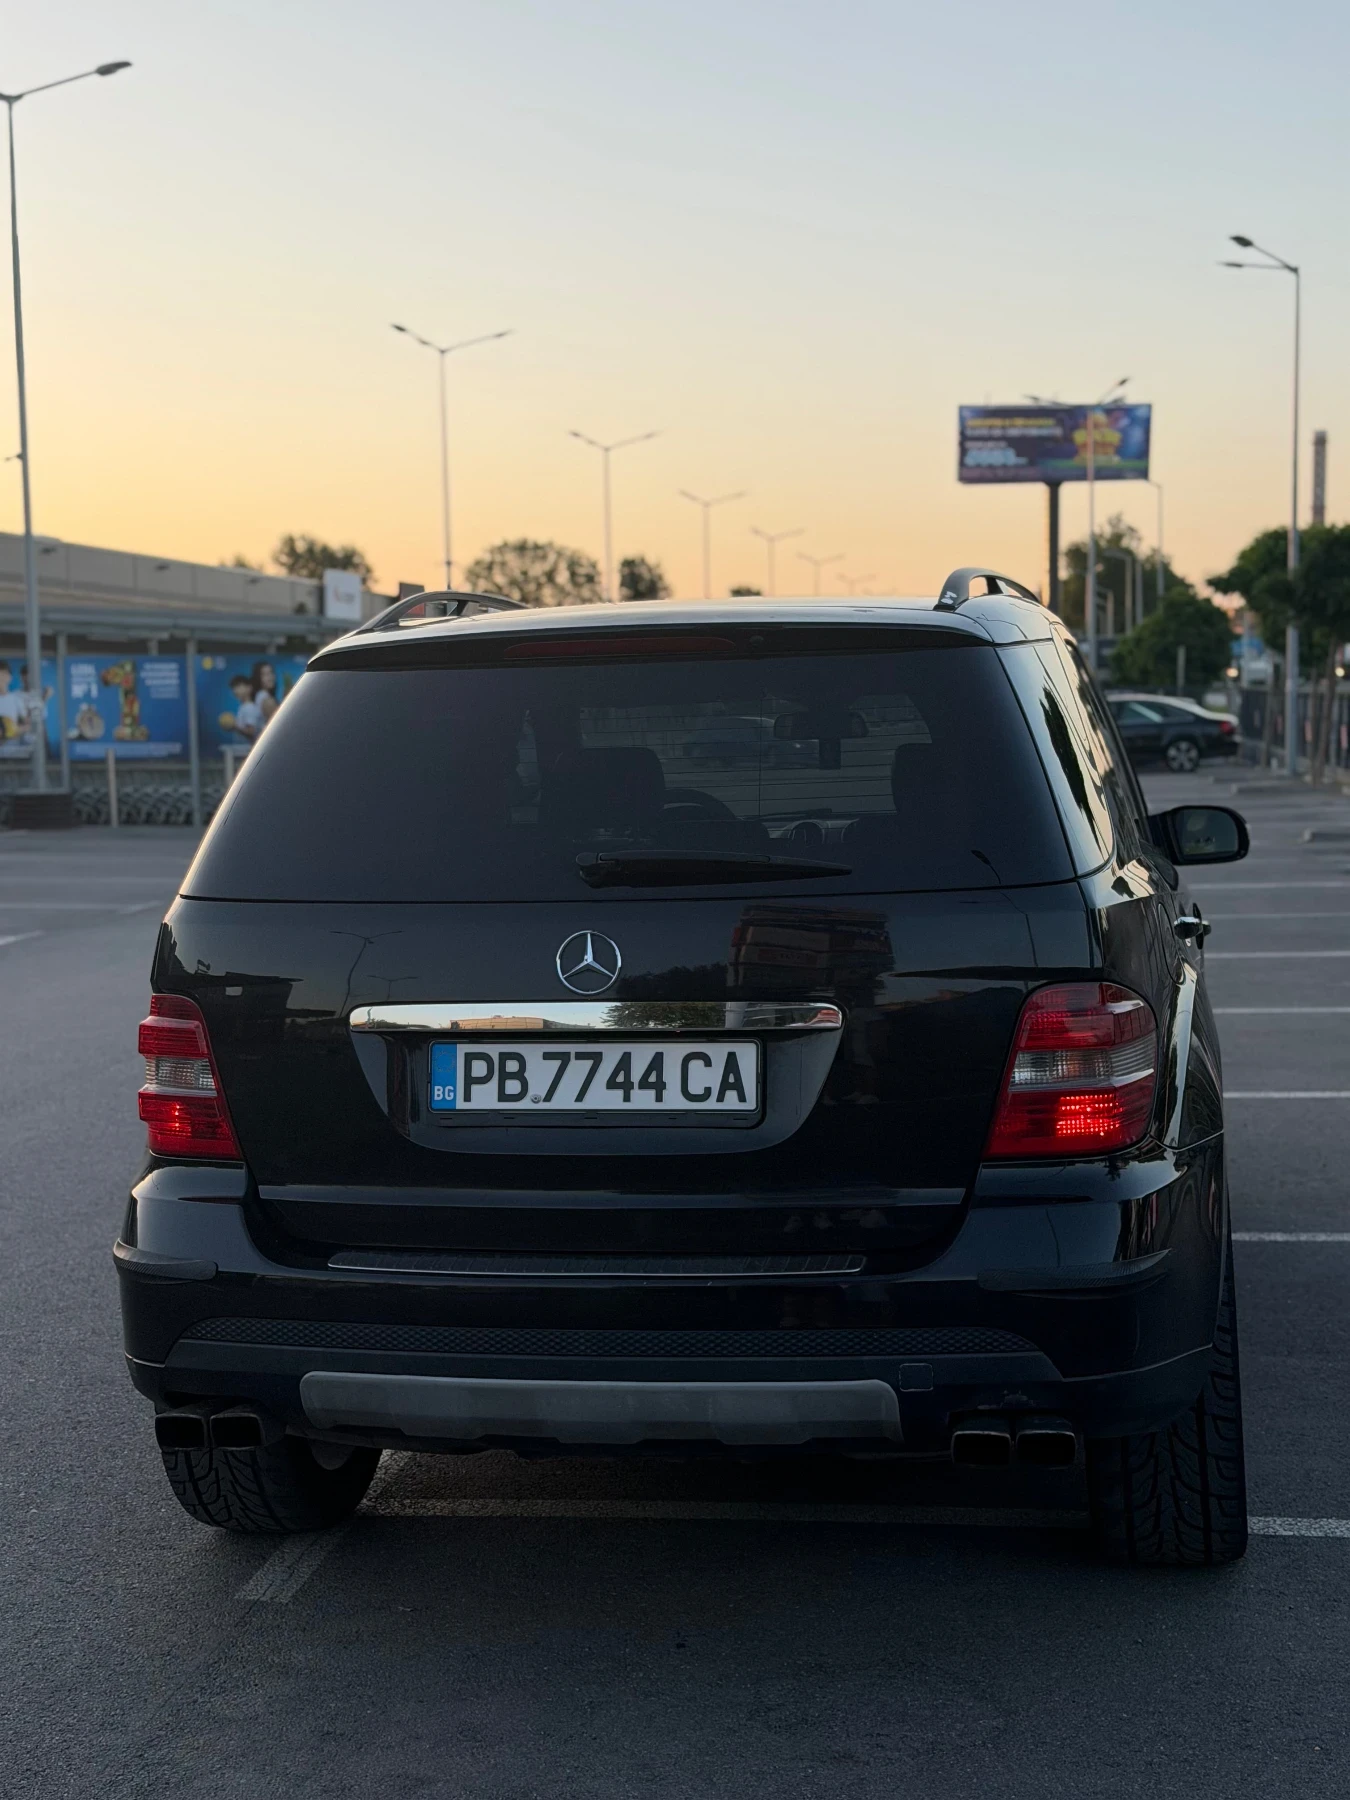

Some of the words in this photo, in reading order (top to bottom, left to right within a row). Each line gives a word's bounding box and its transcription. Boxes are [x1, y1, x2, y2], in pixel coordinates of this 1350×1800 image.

[434, 1085, 455, 1101] BG
[463, 1051, 529, 1103] PB
[542, 1051, 667, 1103] 7744
[680, 1051, 748, 1103] CA
